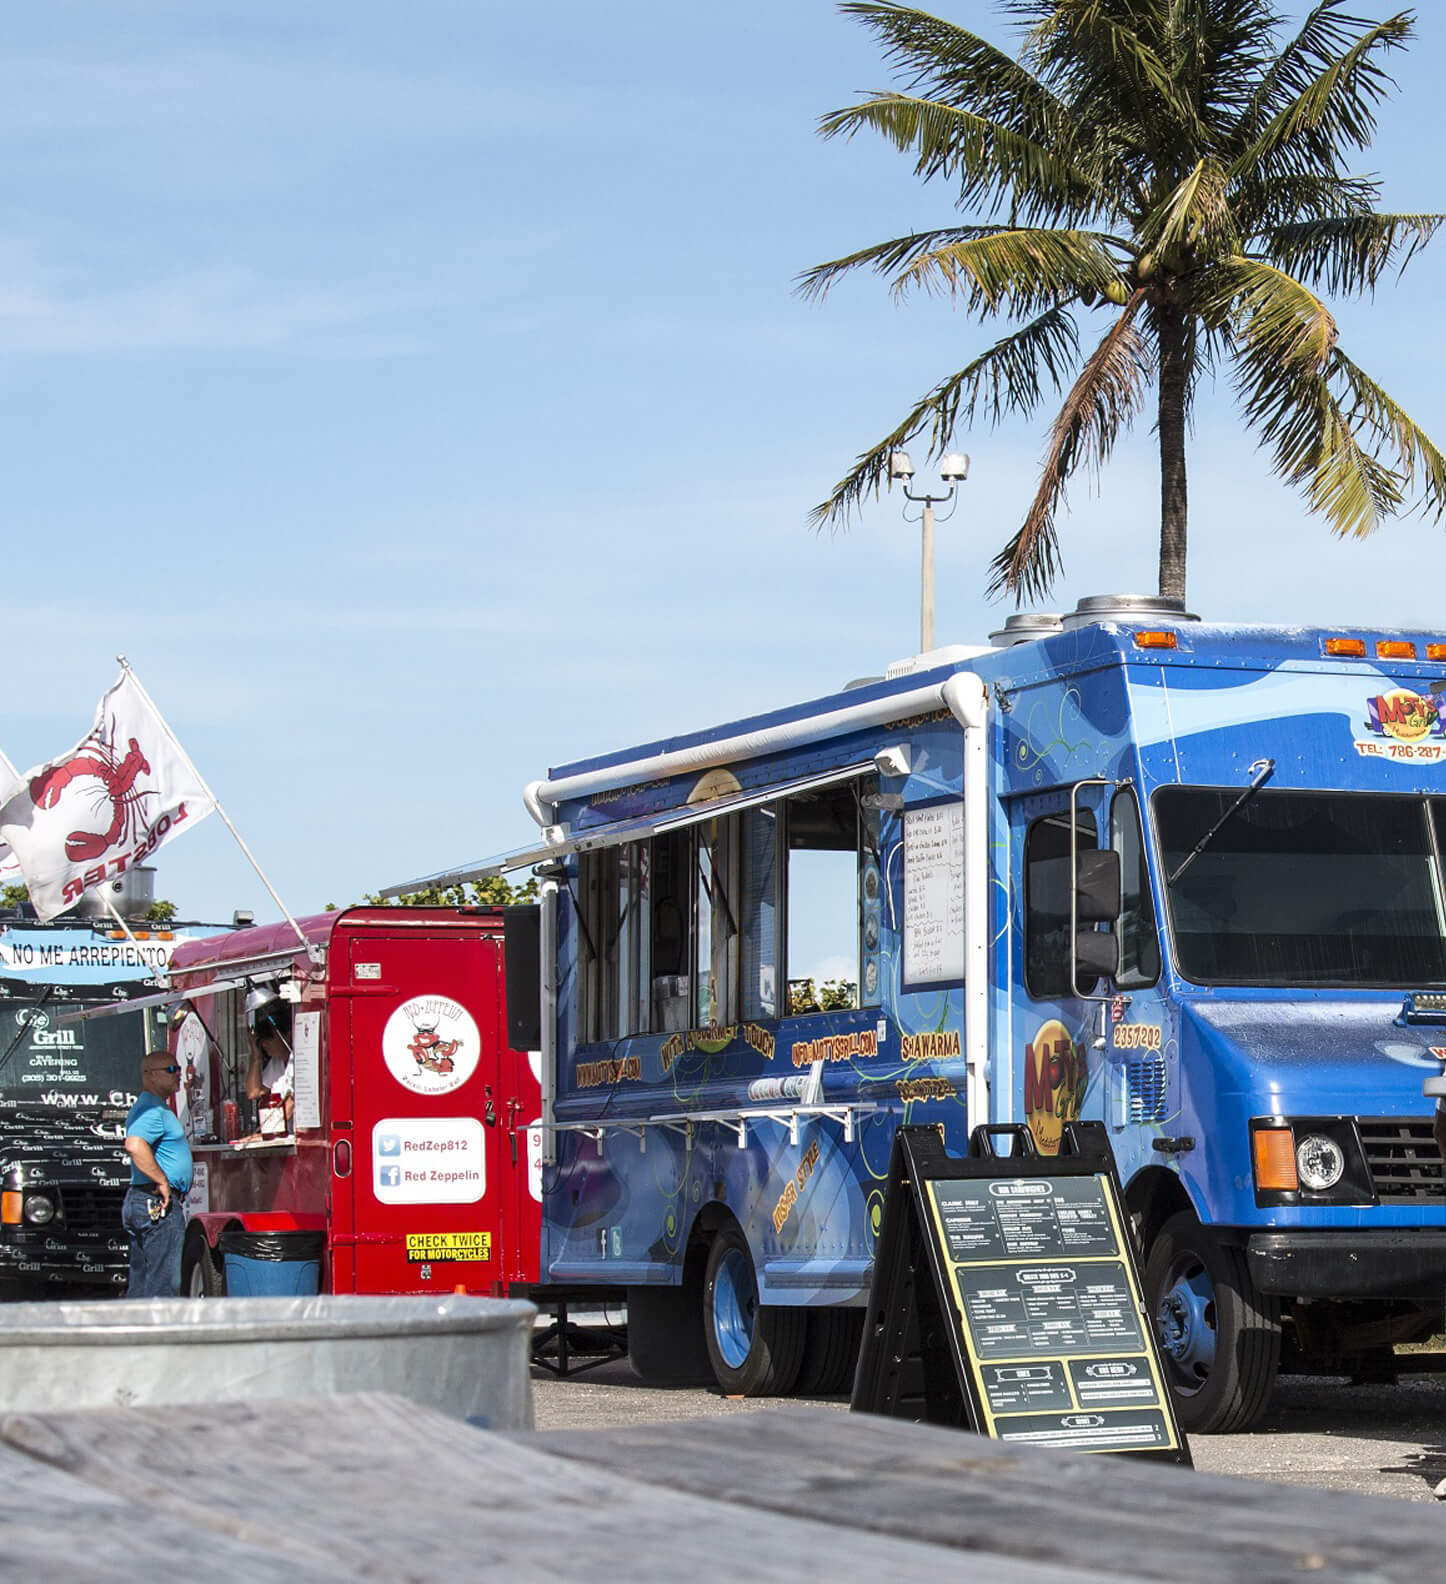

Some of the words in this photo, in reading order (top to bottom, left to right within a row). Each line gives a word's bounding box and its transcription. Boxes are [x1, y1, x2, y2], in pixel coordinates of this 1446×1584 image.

[13, 944, 33, 964] NO
[40, 945, 63, 966] ME
[69, 946, 167, 967] ARREPIENTO
[33, 1030, 75, 1045] Grill
[1114, 1024, 1162, 1048] 2357202
[404, 1140, 468, 1152] RedZep812
[405, 1171, 427, 1181] Red
[430, 1170, 480, 1183] Zeppelin
[409, 1235, 448, 1248] CHECK
[452, 1234, 488, 1247] TWICE
[409, 1250, 426, 1260] FOR
[427, 1248, 489, 1260] MOTORCYCLES
